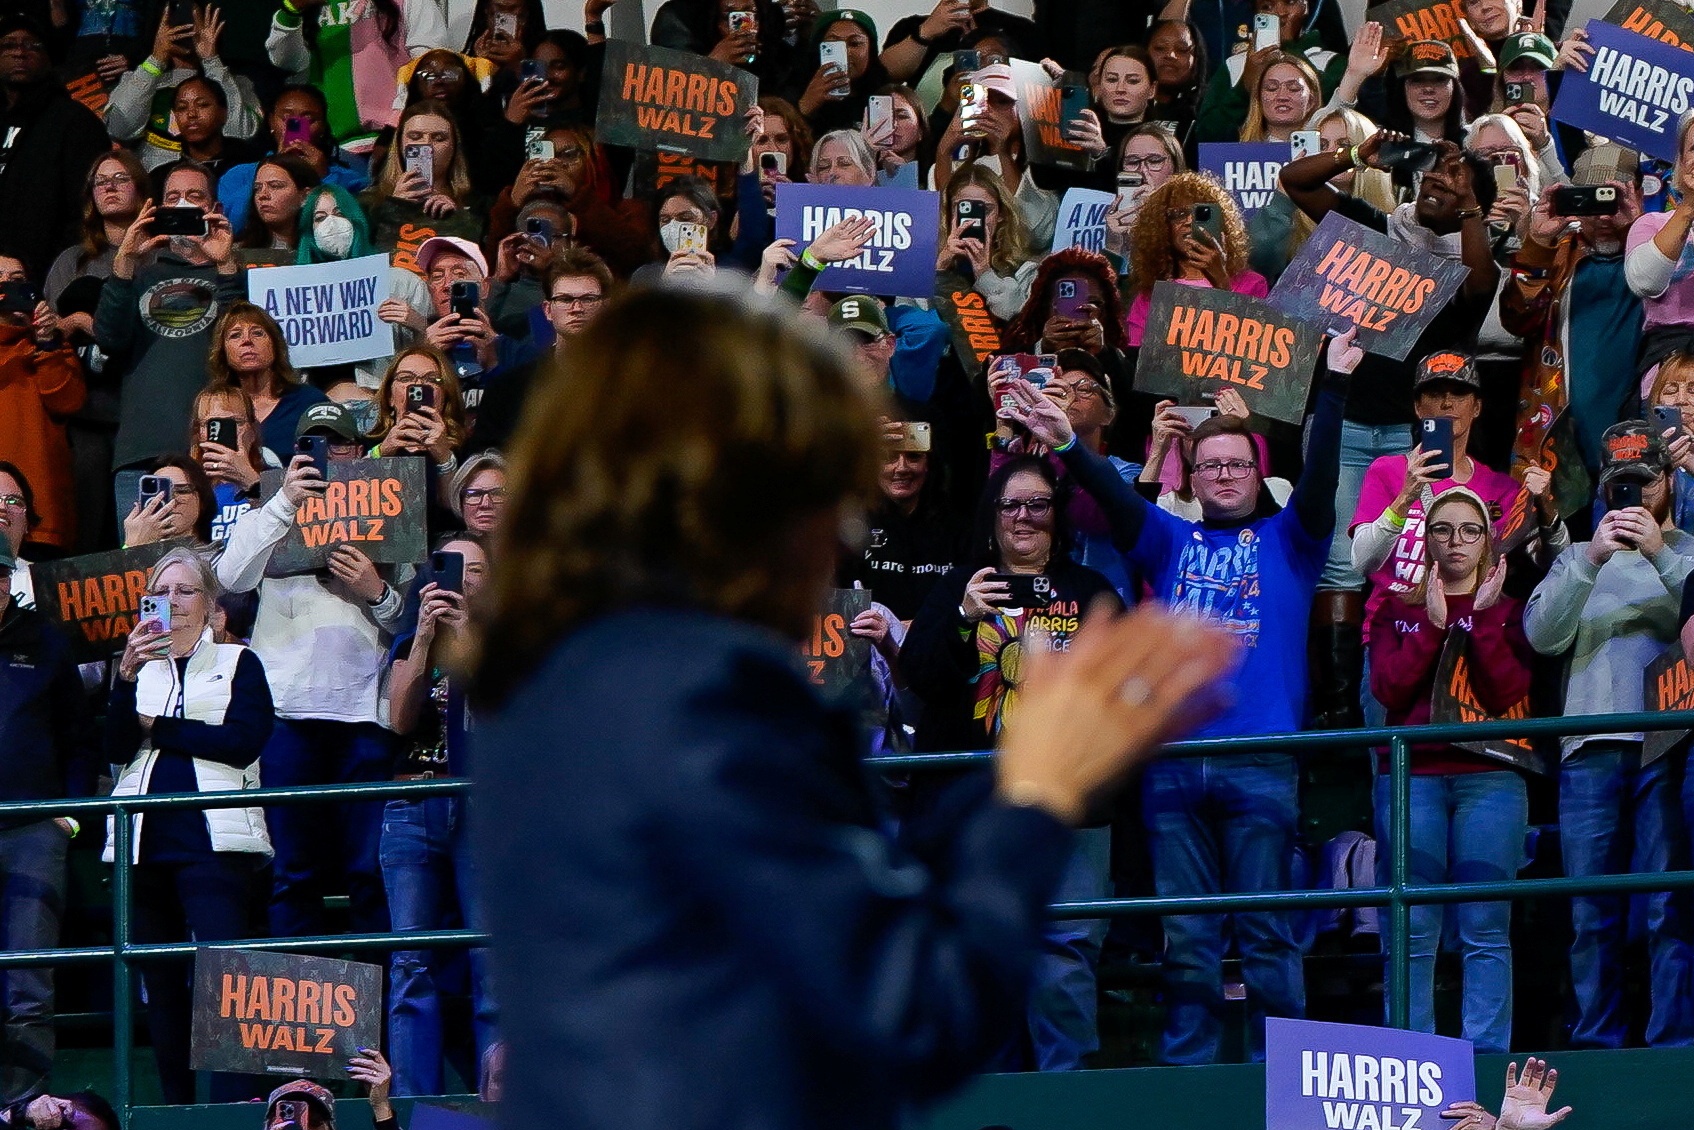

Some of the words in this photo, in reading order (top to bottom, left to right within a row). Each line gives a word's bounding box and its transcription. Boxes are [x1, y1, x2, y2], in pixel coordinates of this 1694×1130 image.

[623, 63, 737, 117] HARRIS
[1590, 46, 1694, 115] HARRIS
[636, 106, 716, 138] WALZ
[1599, 88, 1670, 134] WALZ
[1067, 203, 1082, 229] A
[823, 247, 895, 272] ALZ
[1315, 240, 1436, 315] HARRIS
[265, 288, 280, 316] A
[284, 284, 333, 315] NEW
[336, 275, 378, 308] WAY
[1318, 286, 1400, 333] WALZ
[951, 290, 1001, 362] ARRIS
[1167, 305, 1295, 369] HARRIS
[1182, 350, 1268, 390] WALZ
[297, 478, 402, 521] ARRIS
[303, 516, 384, 548] WALZ
[881, 561, 905, 573] are
[58, 566, 153, 623] HARR
[1027, 615, 1079, 634] ARRIS
[220, 973, 356, 1028] HARRIS
[239, 1022, 336, 1055] WALZ
[1302, 1050, 1443, 1107] HARRIS
